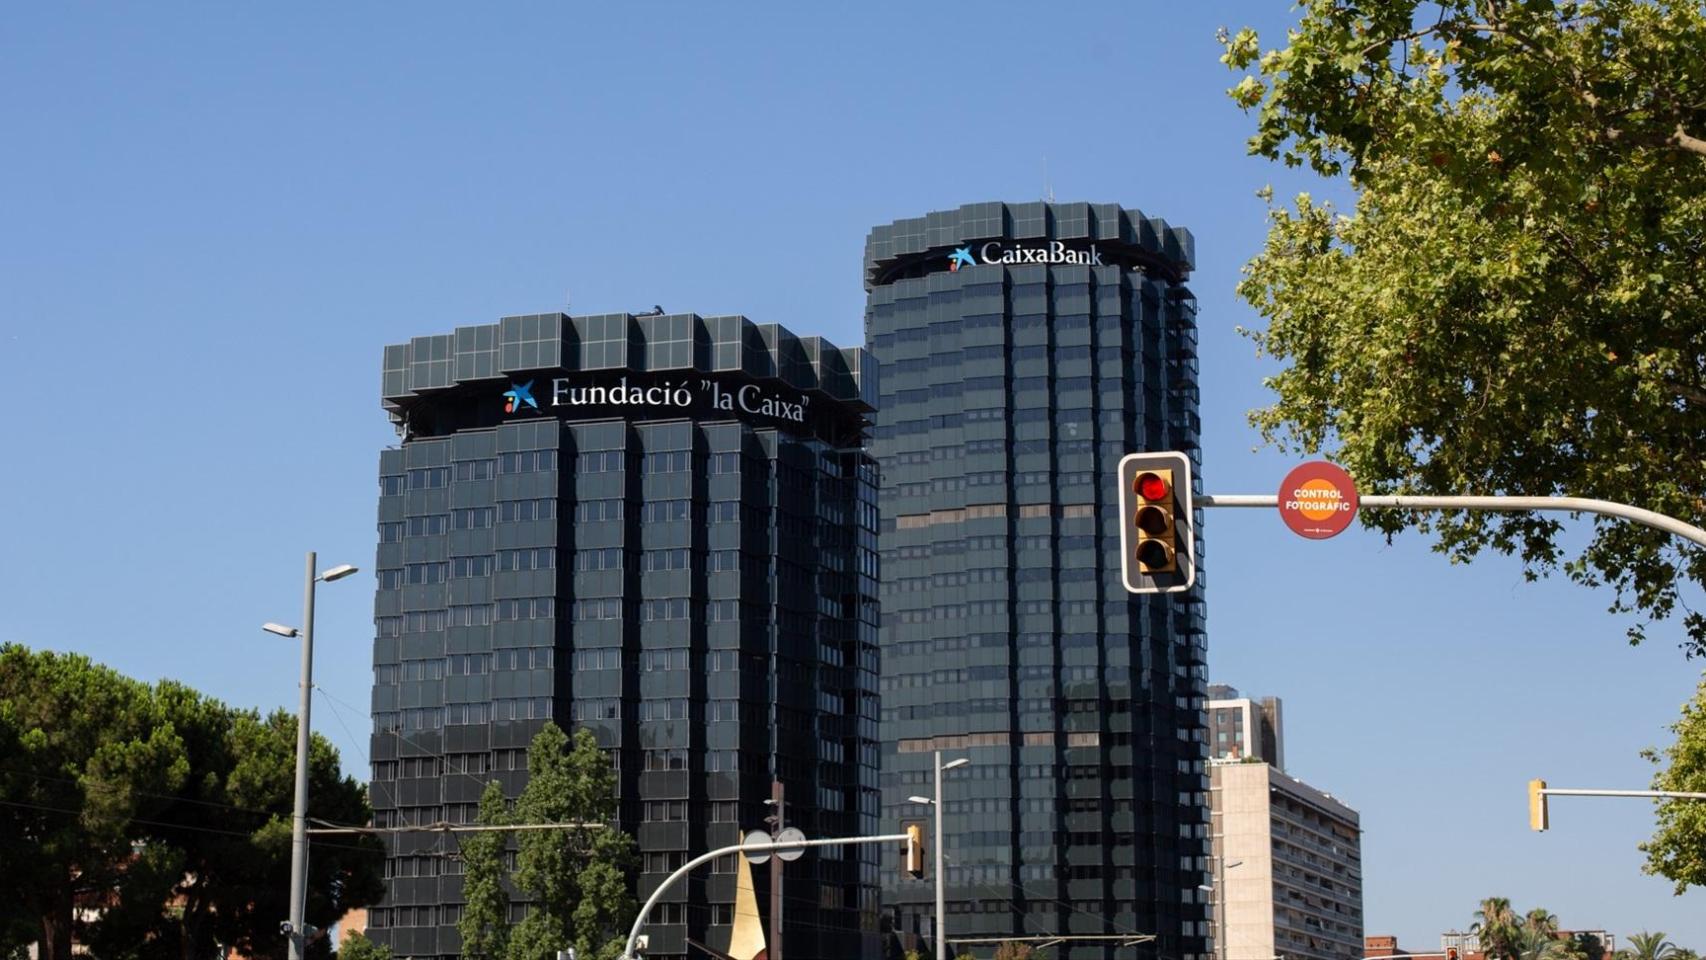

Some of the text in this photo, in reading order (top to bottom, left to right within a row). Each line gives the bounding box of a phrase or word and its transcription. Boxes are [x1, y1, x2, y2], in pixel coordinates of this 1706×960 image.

[981, 241, 1103, 265] CaixaBank
[551, 377, 691, 407] Fundació
[1294, 489, 1343, 499] CONTROL
[1286, 500, 1350, 511] FOTOGRÀFIC
